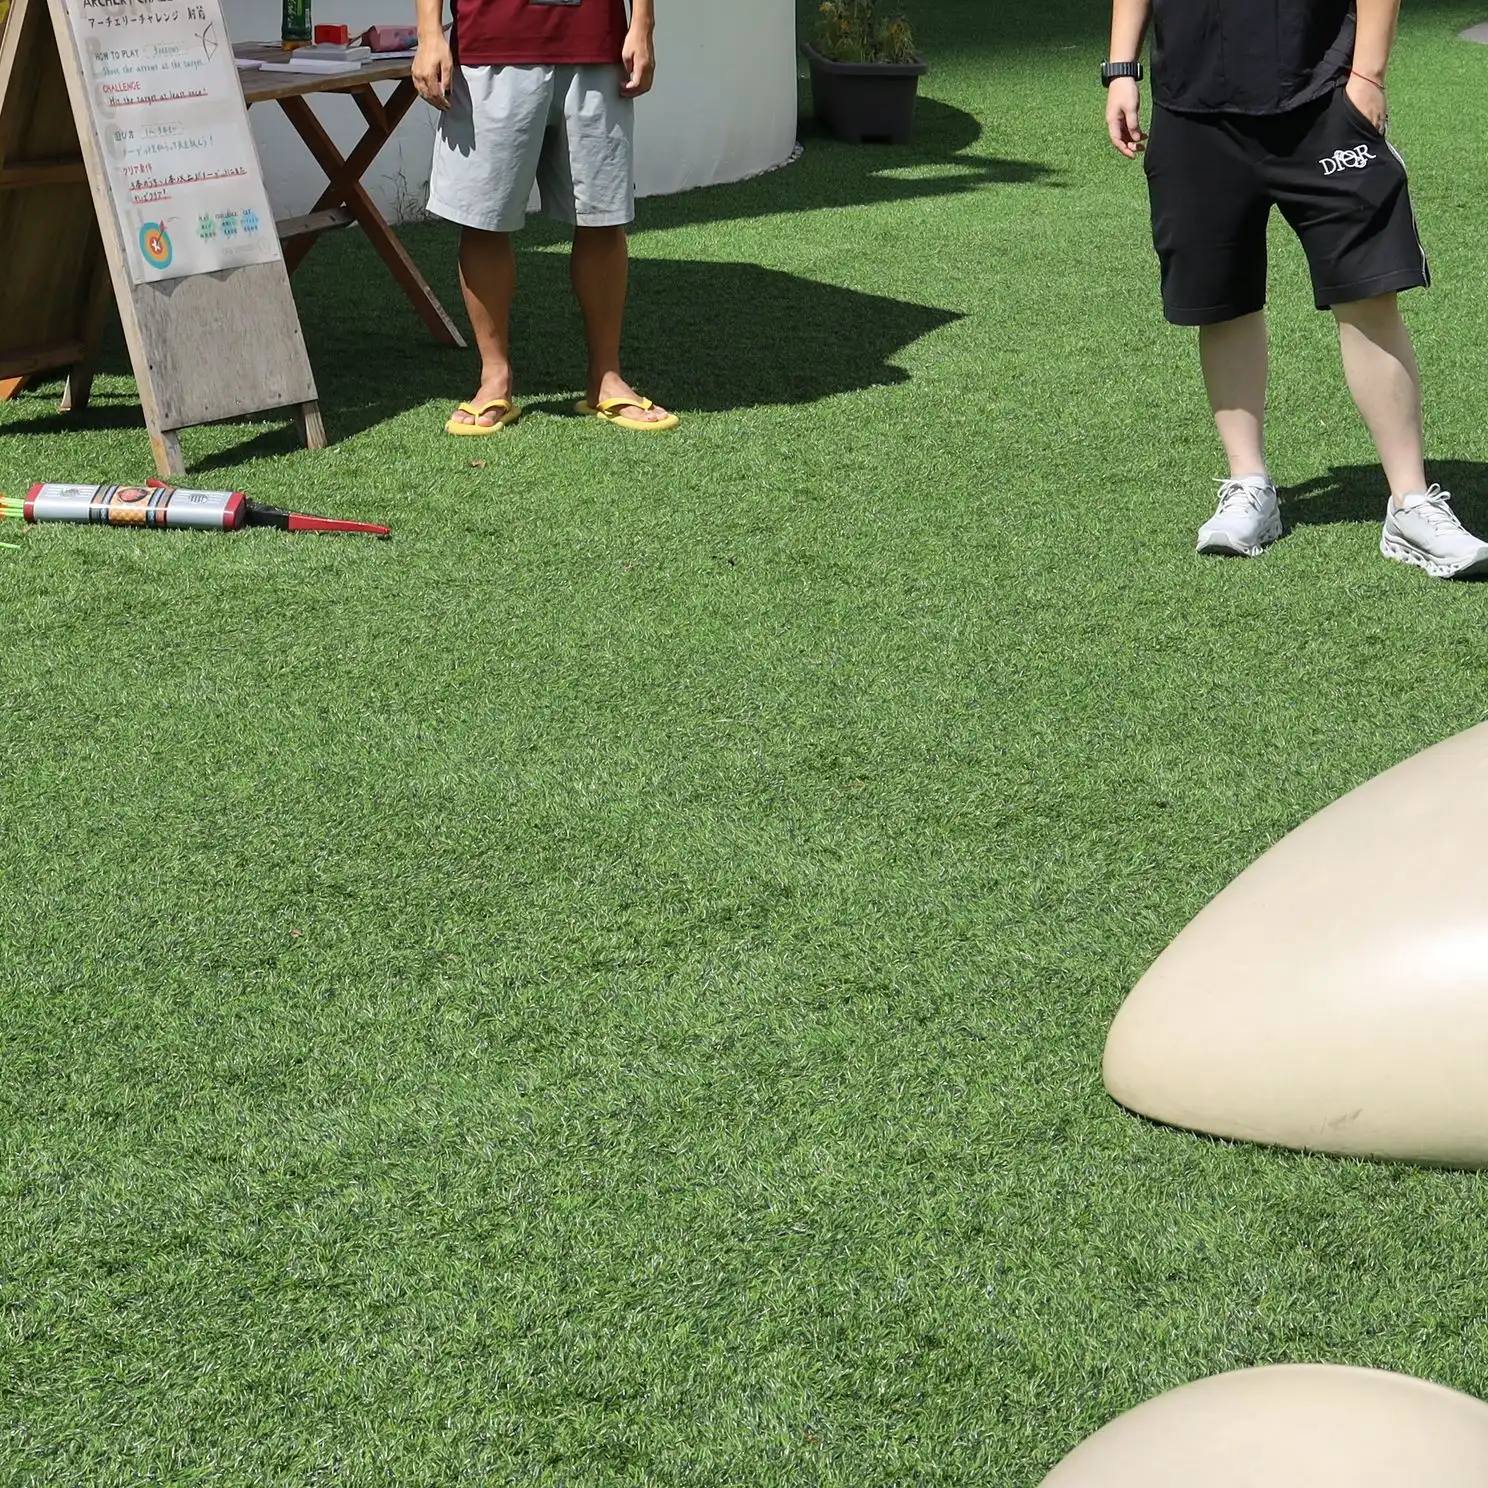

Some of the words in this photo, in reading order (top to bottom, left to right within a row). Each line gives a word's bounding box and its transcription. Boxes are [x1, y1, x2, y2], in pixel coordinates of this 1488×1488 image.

[87, 9, 179, 29] アーチェリーチャレンジ
[95, 51, 109, 62] HOW
[111, 50, 120, 61] TO
[122, 49, 140, 60] PLAY
[123, 64, 133, 73] the
[171, 59, 181, 69] the
[102, 80, 141, 93] CHALLENGE
[123, 95, 133, 104] the
[1318, 144, 1377, 176] DIOR
